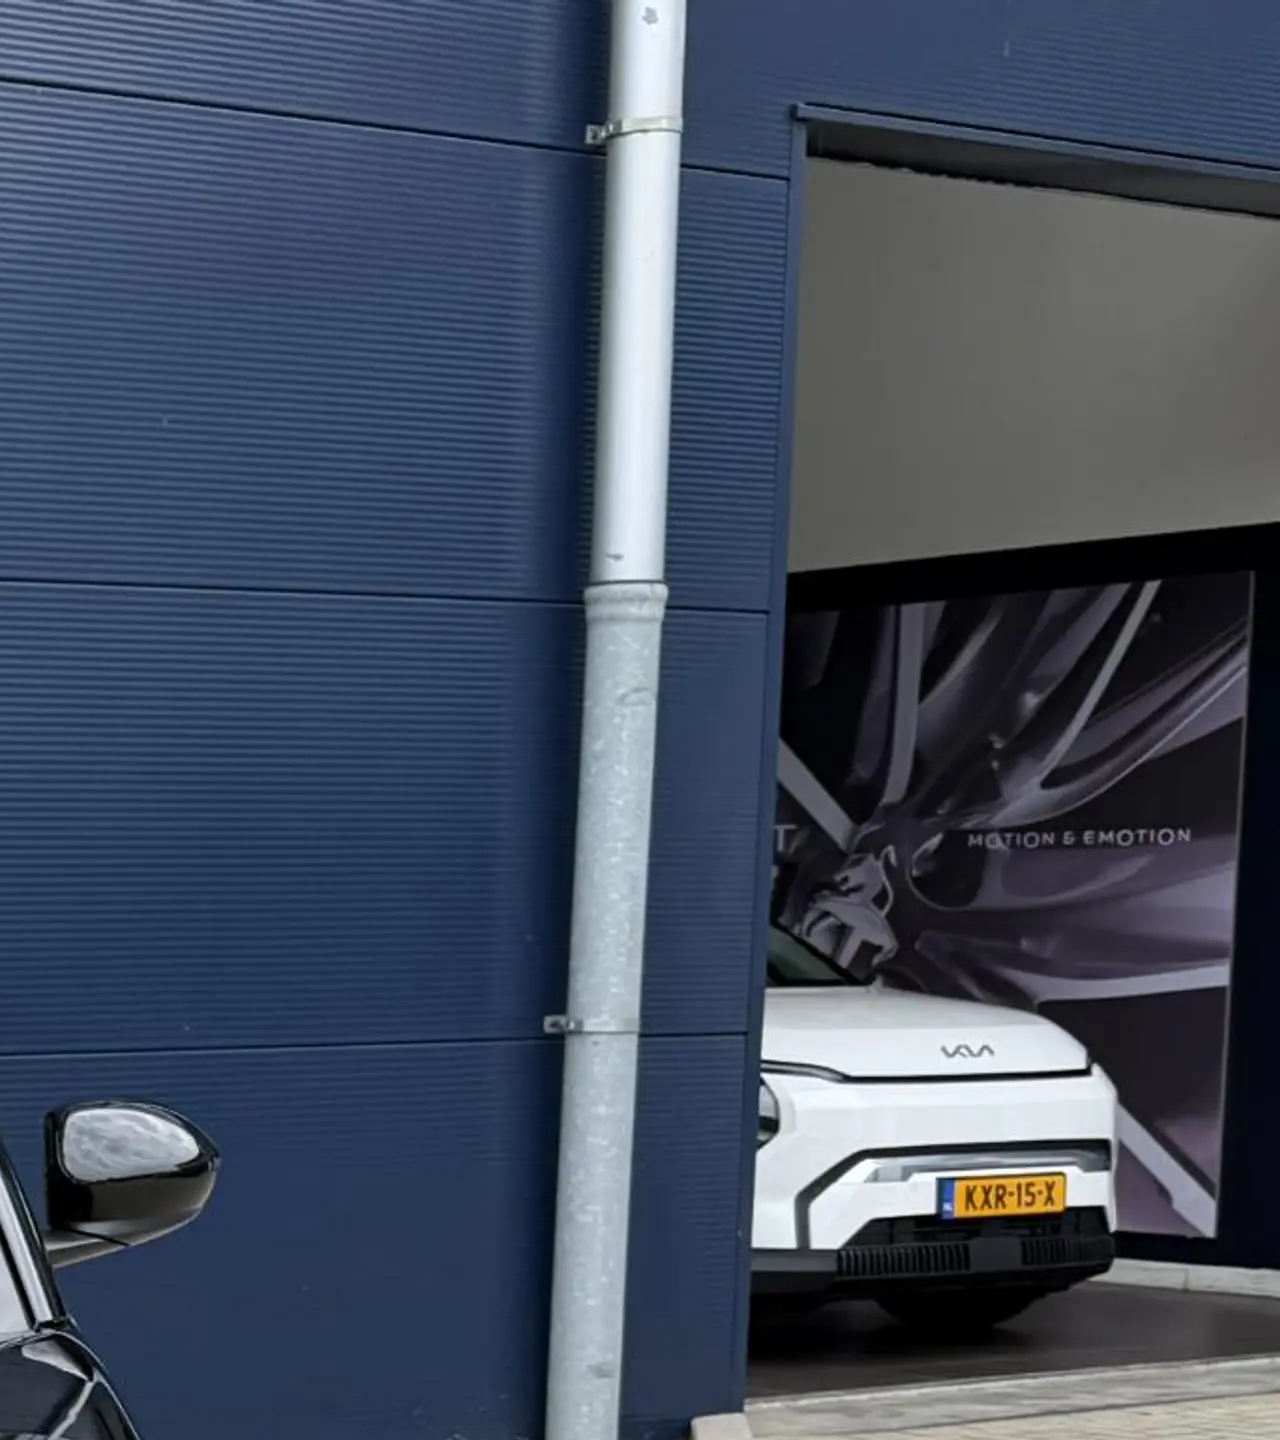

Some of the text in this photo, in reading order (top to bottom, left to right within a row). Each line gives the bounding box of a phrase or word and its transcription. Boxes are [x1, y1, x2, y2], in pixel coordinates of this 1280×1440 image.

[967, 831, 1055, 849] MOTION
[1082, 827, 1191, 847] EMOTION
[964, 1180, 1057, 1212] KXR-15-X
